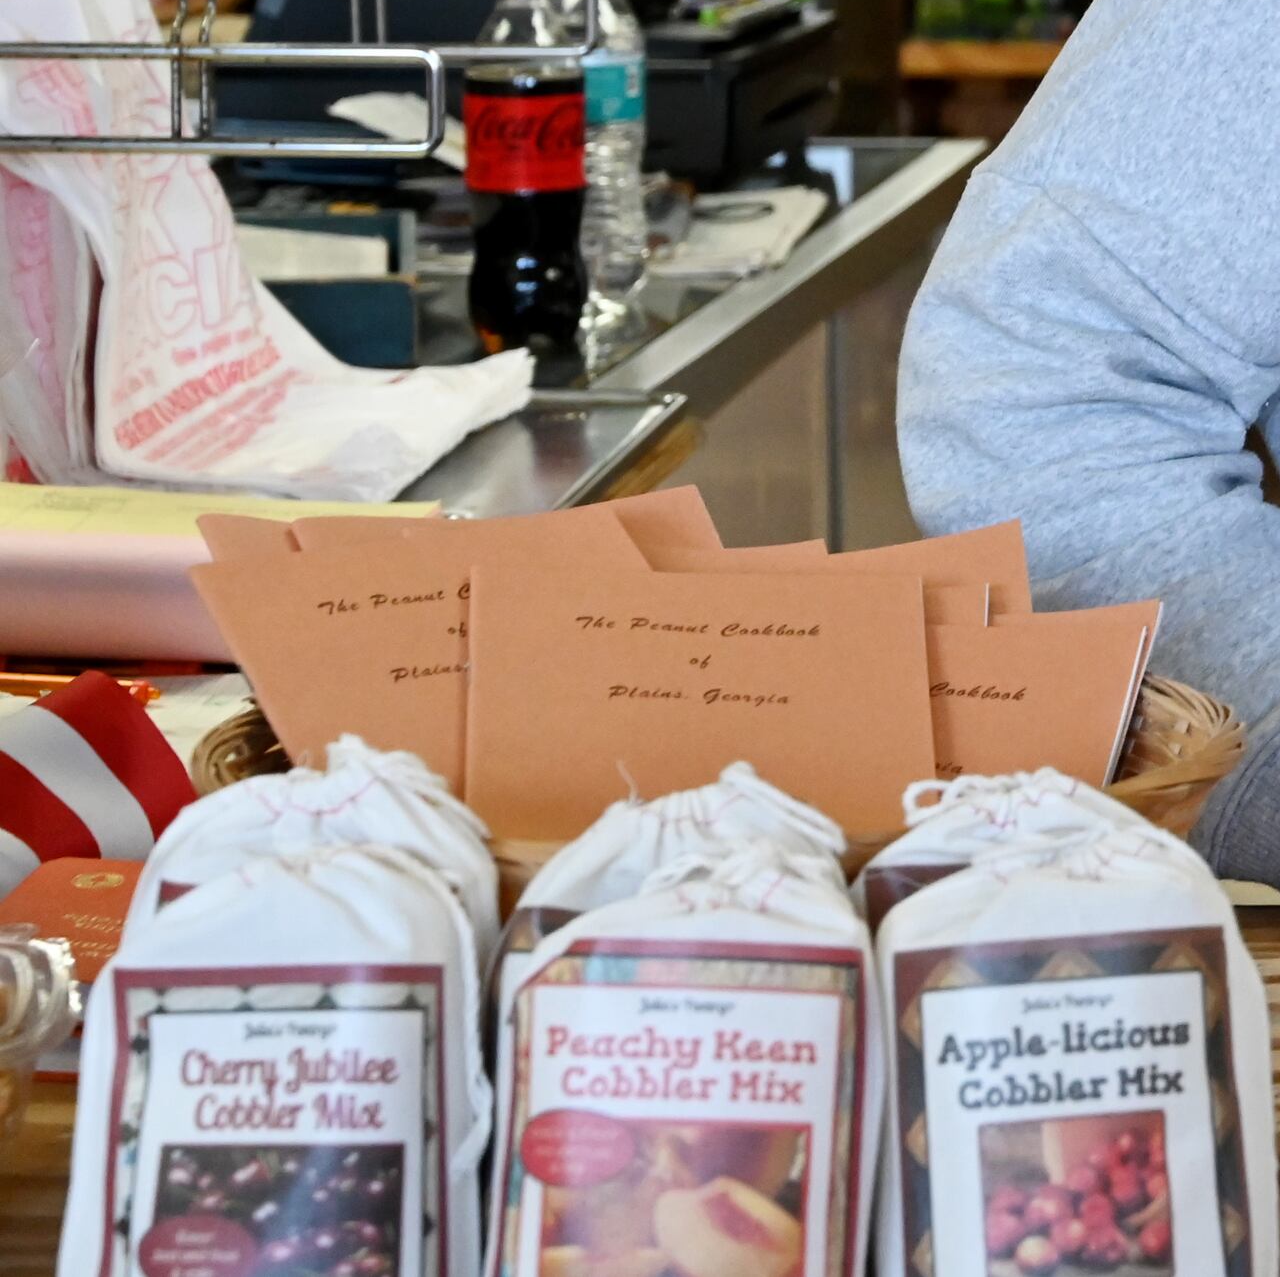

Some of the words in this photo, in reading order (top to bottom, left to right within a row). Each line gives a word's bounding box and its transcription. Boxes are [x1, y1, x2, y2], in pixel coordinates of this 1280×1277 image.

[318, 600, 358, 616] The
[372, 589, 446, 609] Peanut
[447, 622, 468, 638] of
[575, 615, 616, 630] The
[630, 616, 709, 634] Peanut
[720, 622, 822, 639] Cookbook
[689, 654, 711, 669] of
[703, 688, 790, 707] Georgia
[930, 681, 1027, 702] Cookbook
[544, 1025, 704, 1070] Peachy
[712, 1030, 818, 1065] Keen
[937, 1019, 1190, 1071] Apple-licious
[181, 1048, 279, 1096] Cherry
[285, 1046, 402, 1094] Jubilee
[561, 1066, 718, 1101] Cobbler
[729, 1070, 805, 1105] Mix
[959, 1071, 1109, 1109] Cobbler
[1116, 1064, 1185, 1098] Mix
[194, 1093, 304, 1131] Cobbler
[313, 1093, 385, 1130] Mix
